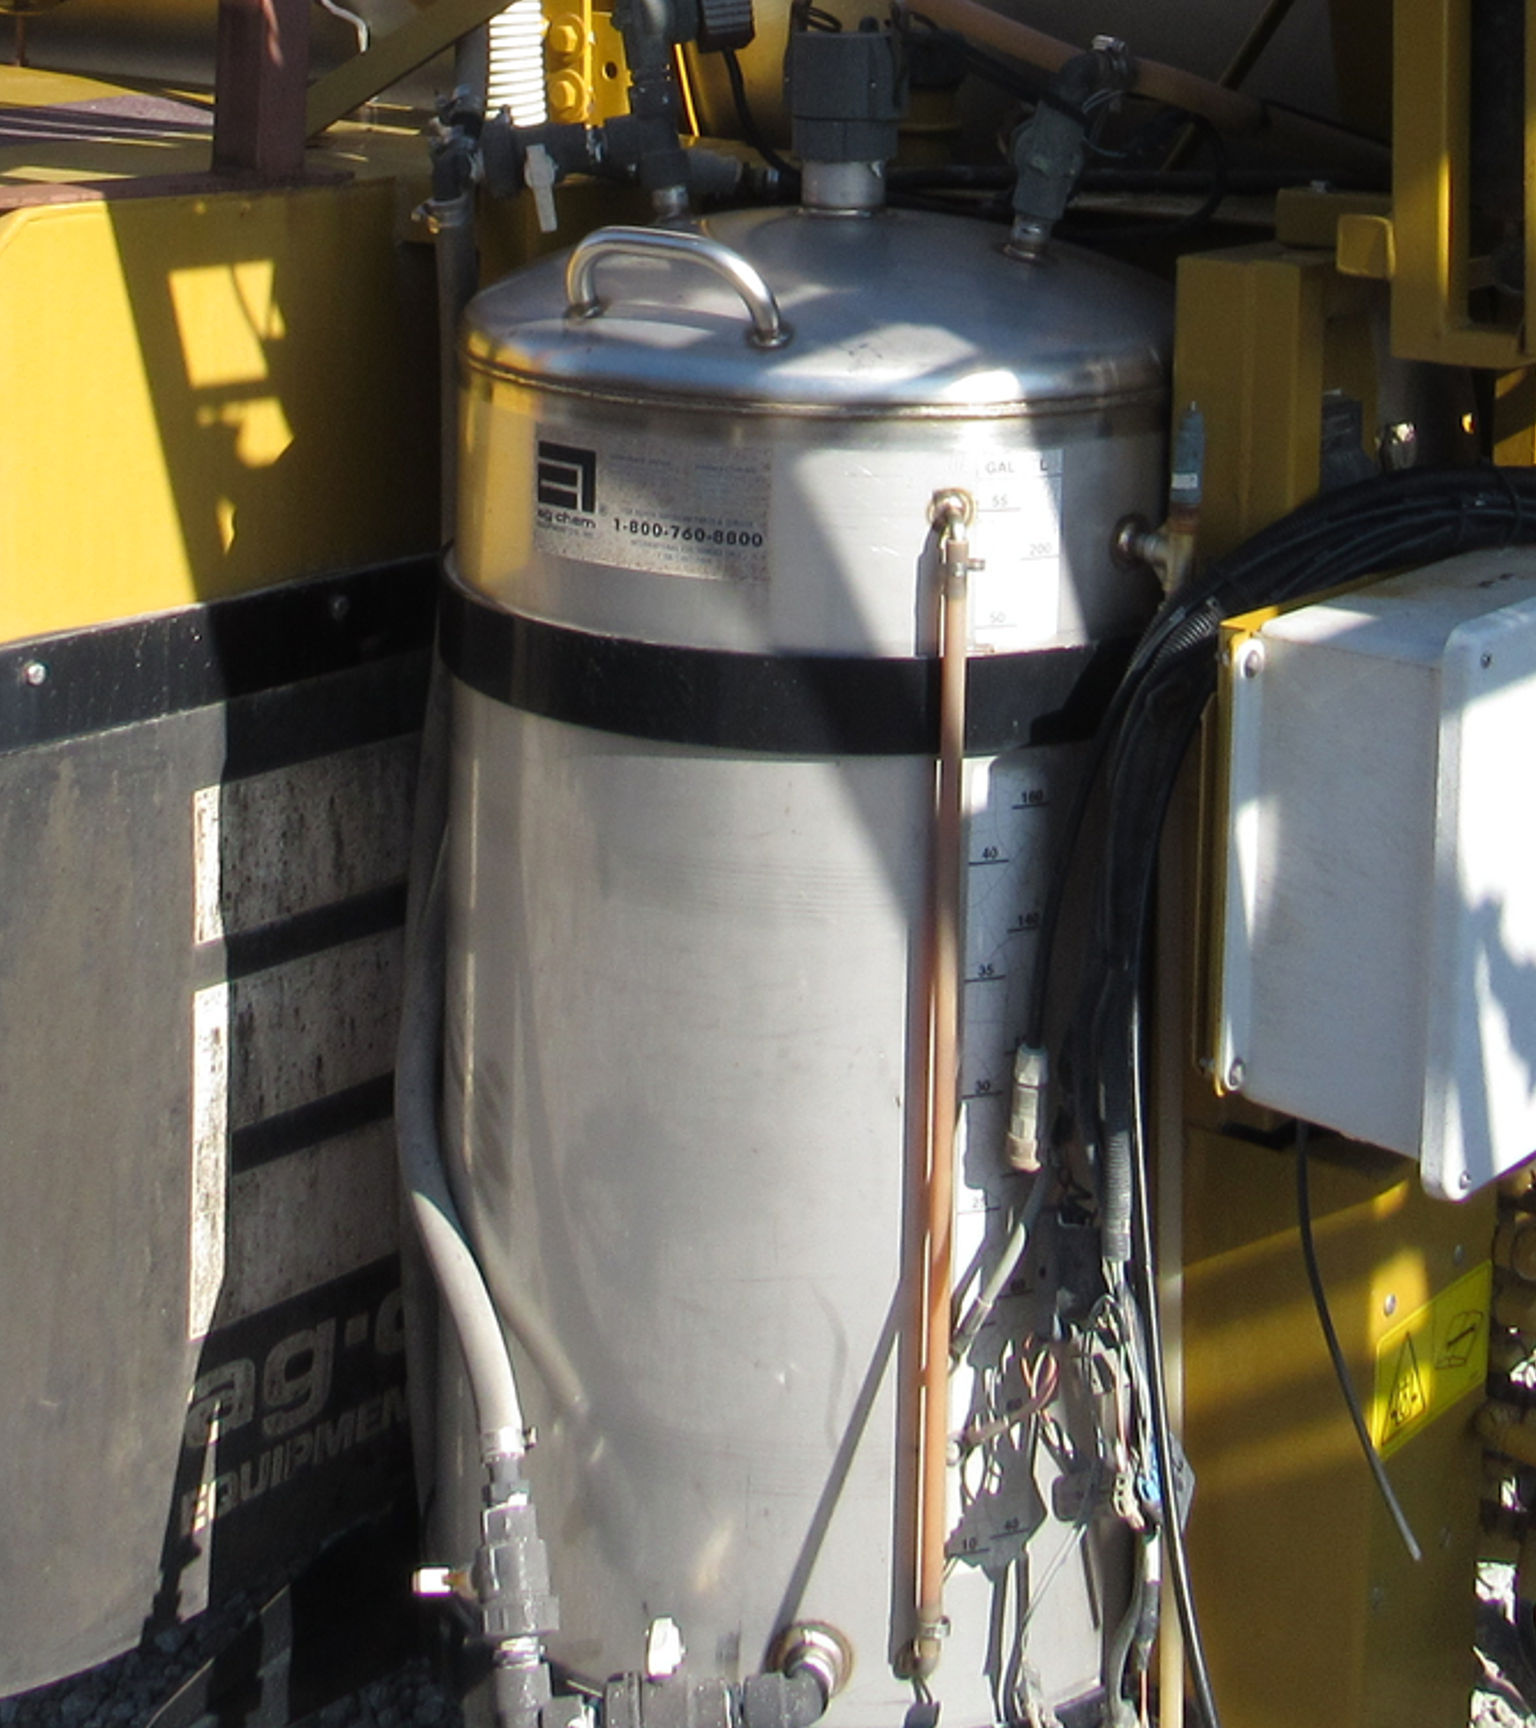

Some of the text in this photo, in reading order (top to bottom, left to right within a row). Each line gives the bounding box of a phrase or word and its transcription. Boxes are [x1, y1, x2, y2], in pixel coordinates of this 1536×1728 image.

[985, 459, 1048, 474] GAL L
[982, 847, 998, 859] 40
[978, 964, 994, 976] 35
